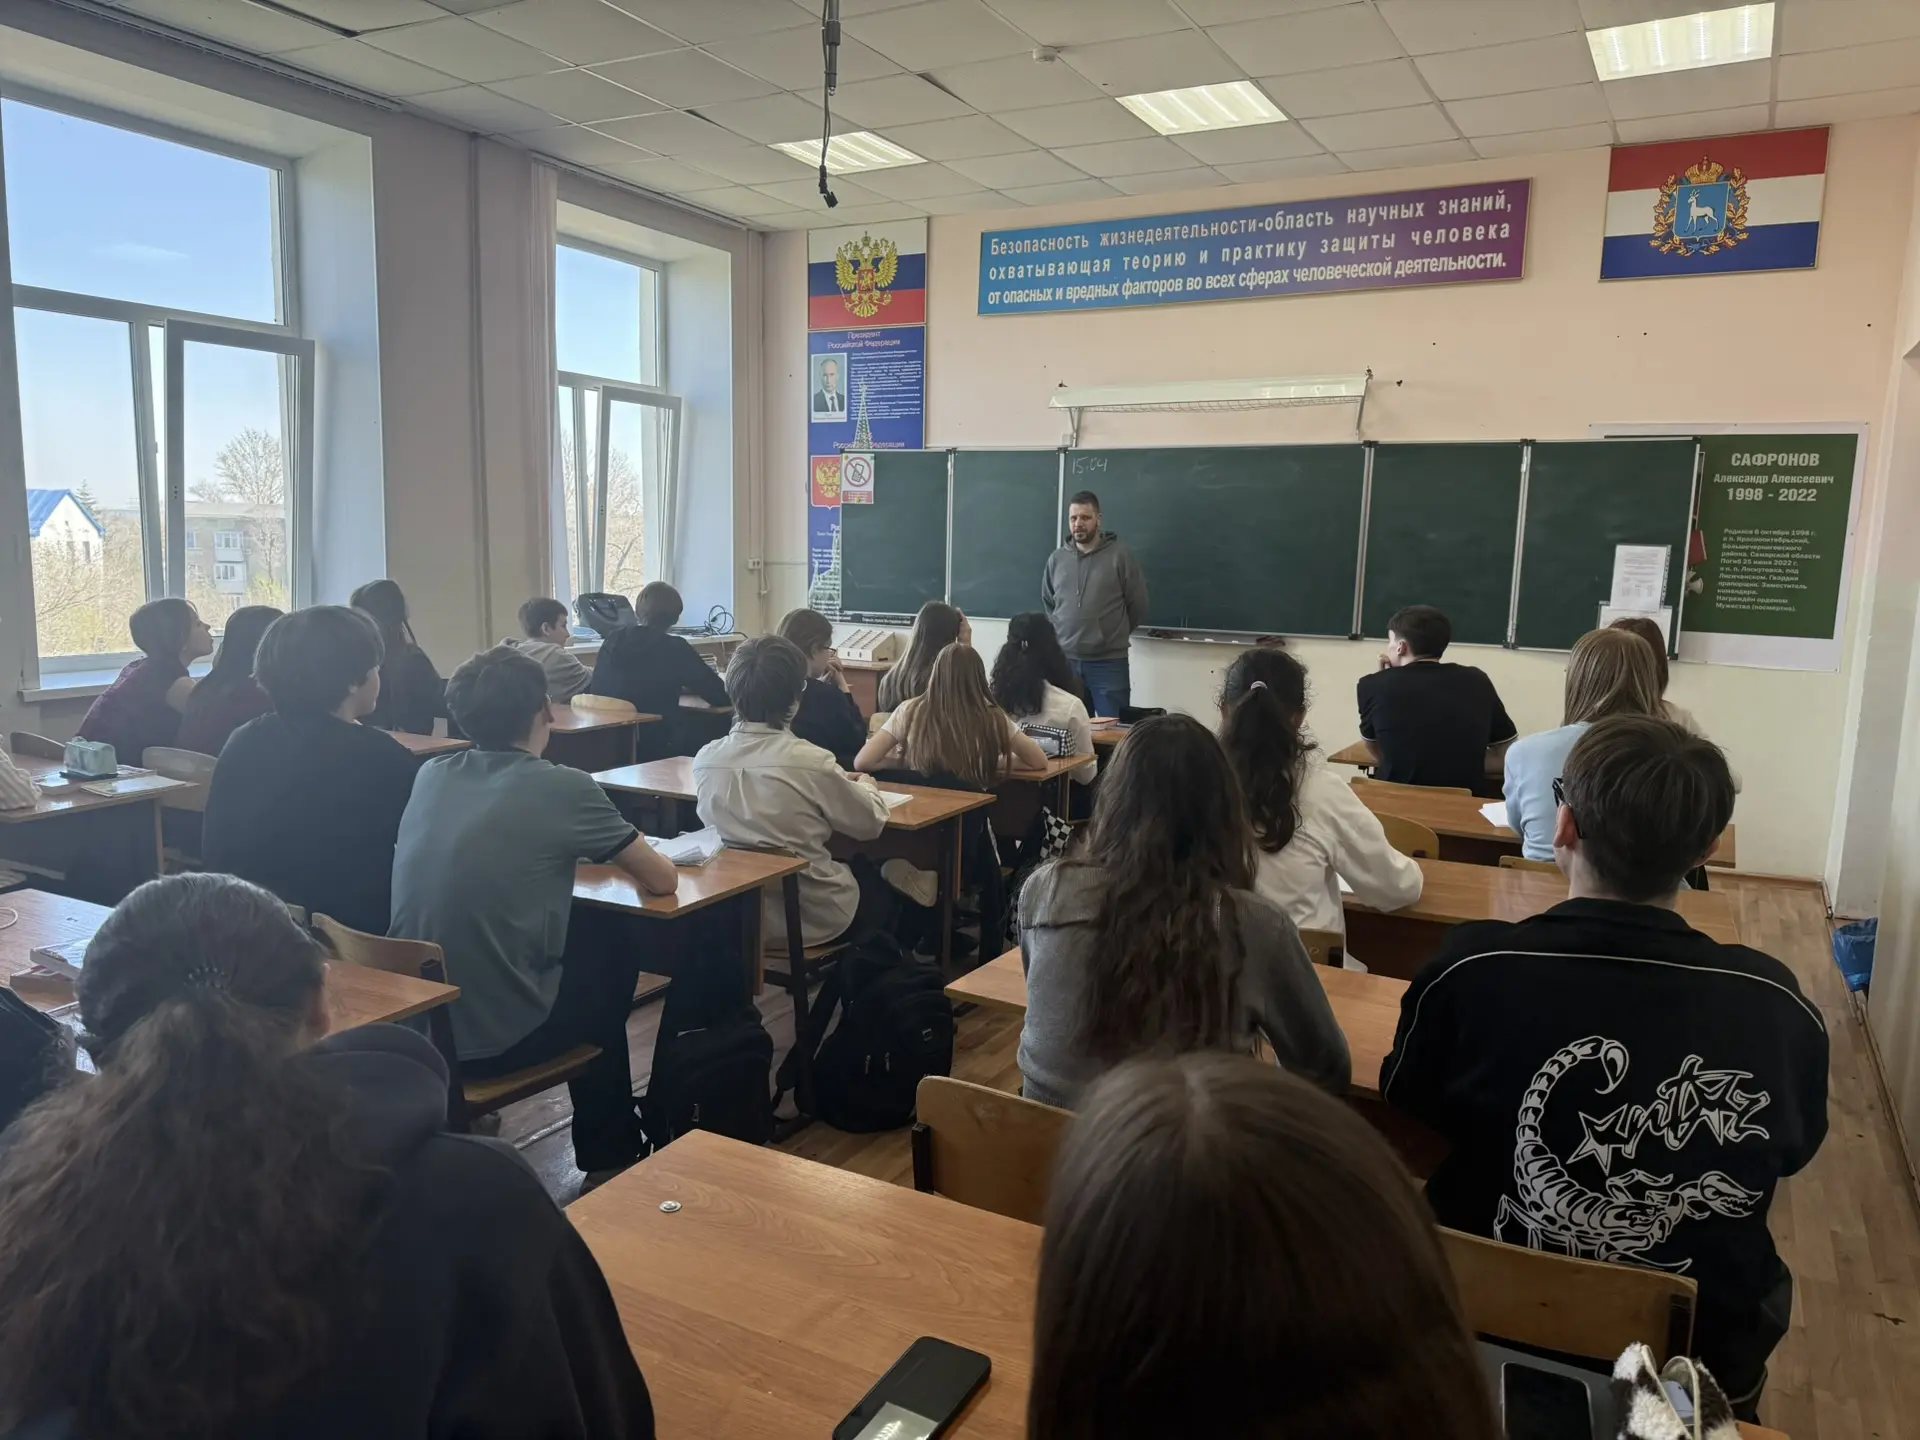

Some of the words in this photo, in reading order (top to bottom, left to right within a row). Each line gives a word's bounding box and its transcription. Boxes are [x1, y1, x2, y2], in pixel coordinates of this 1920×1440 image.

[991, 234, 1089, 256] Безопасность
[1100, 211, 1334, 247] жизнедеятельности-область
[1348, 202, 1424, 227] научных
[1439, 190, 1512, 215] знаний,
[990, 257, 1111, 280] охватывающая
[1123, 251, 1186, 273] теорию
[1200, 250, 1208, 264] и
[1222, 240, 1307, 266] практику
[1320, 233, 1395, 255] защиты
[1411, 222, 1510, 246] человека
[988, 291, 1000, 305] от
[1003, 286, 1052, 304] опасных
[1056, 286, 1063, 300] и
[1067, 282, 1118, 303] вредных
[1122, 277, 1182, 299] факторов
[1187, 276, 1202, 291] во
[1206, 272, 1235, 288] всех
[1239, 268, 1289, 290] сферах
[1294, 256, 1391, 282] человеческой
[1395, 252, 1506, 278] деятельности.
[1731, 453, 1820, 466] САФРОНОВ
[1714, 473, 1769, 484] Александр
[1771, 474, 1834, 484] Алексеевич
[1727, 488, 1763, 501] 1998
[1778, 488, 1817, 501] 2022
